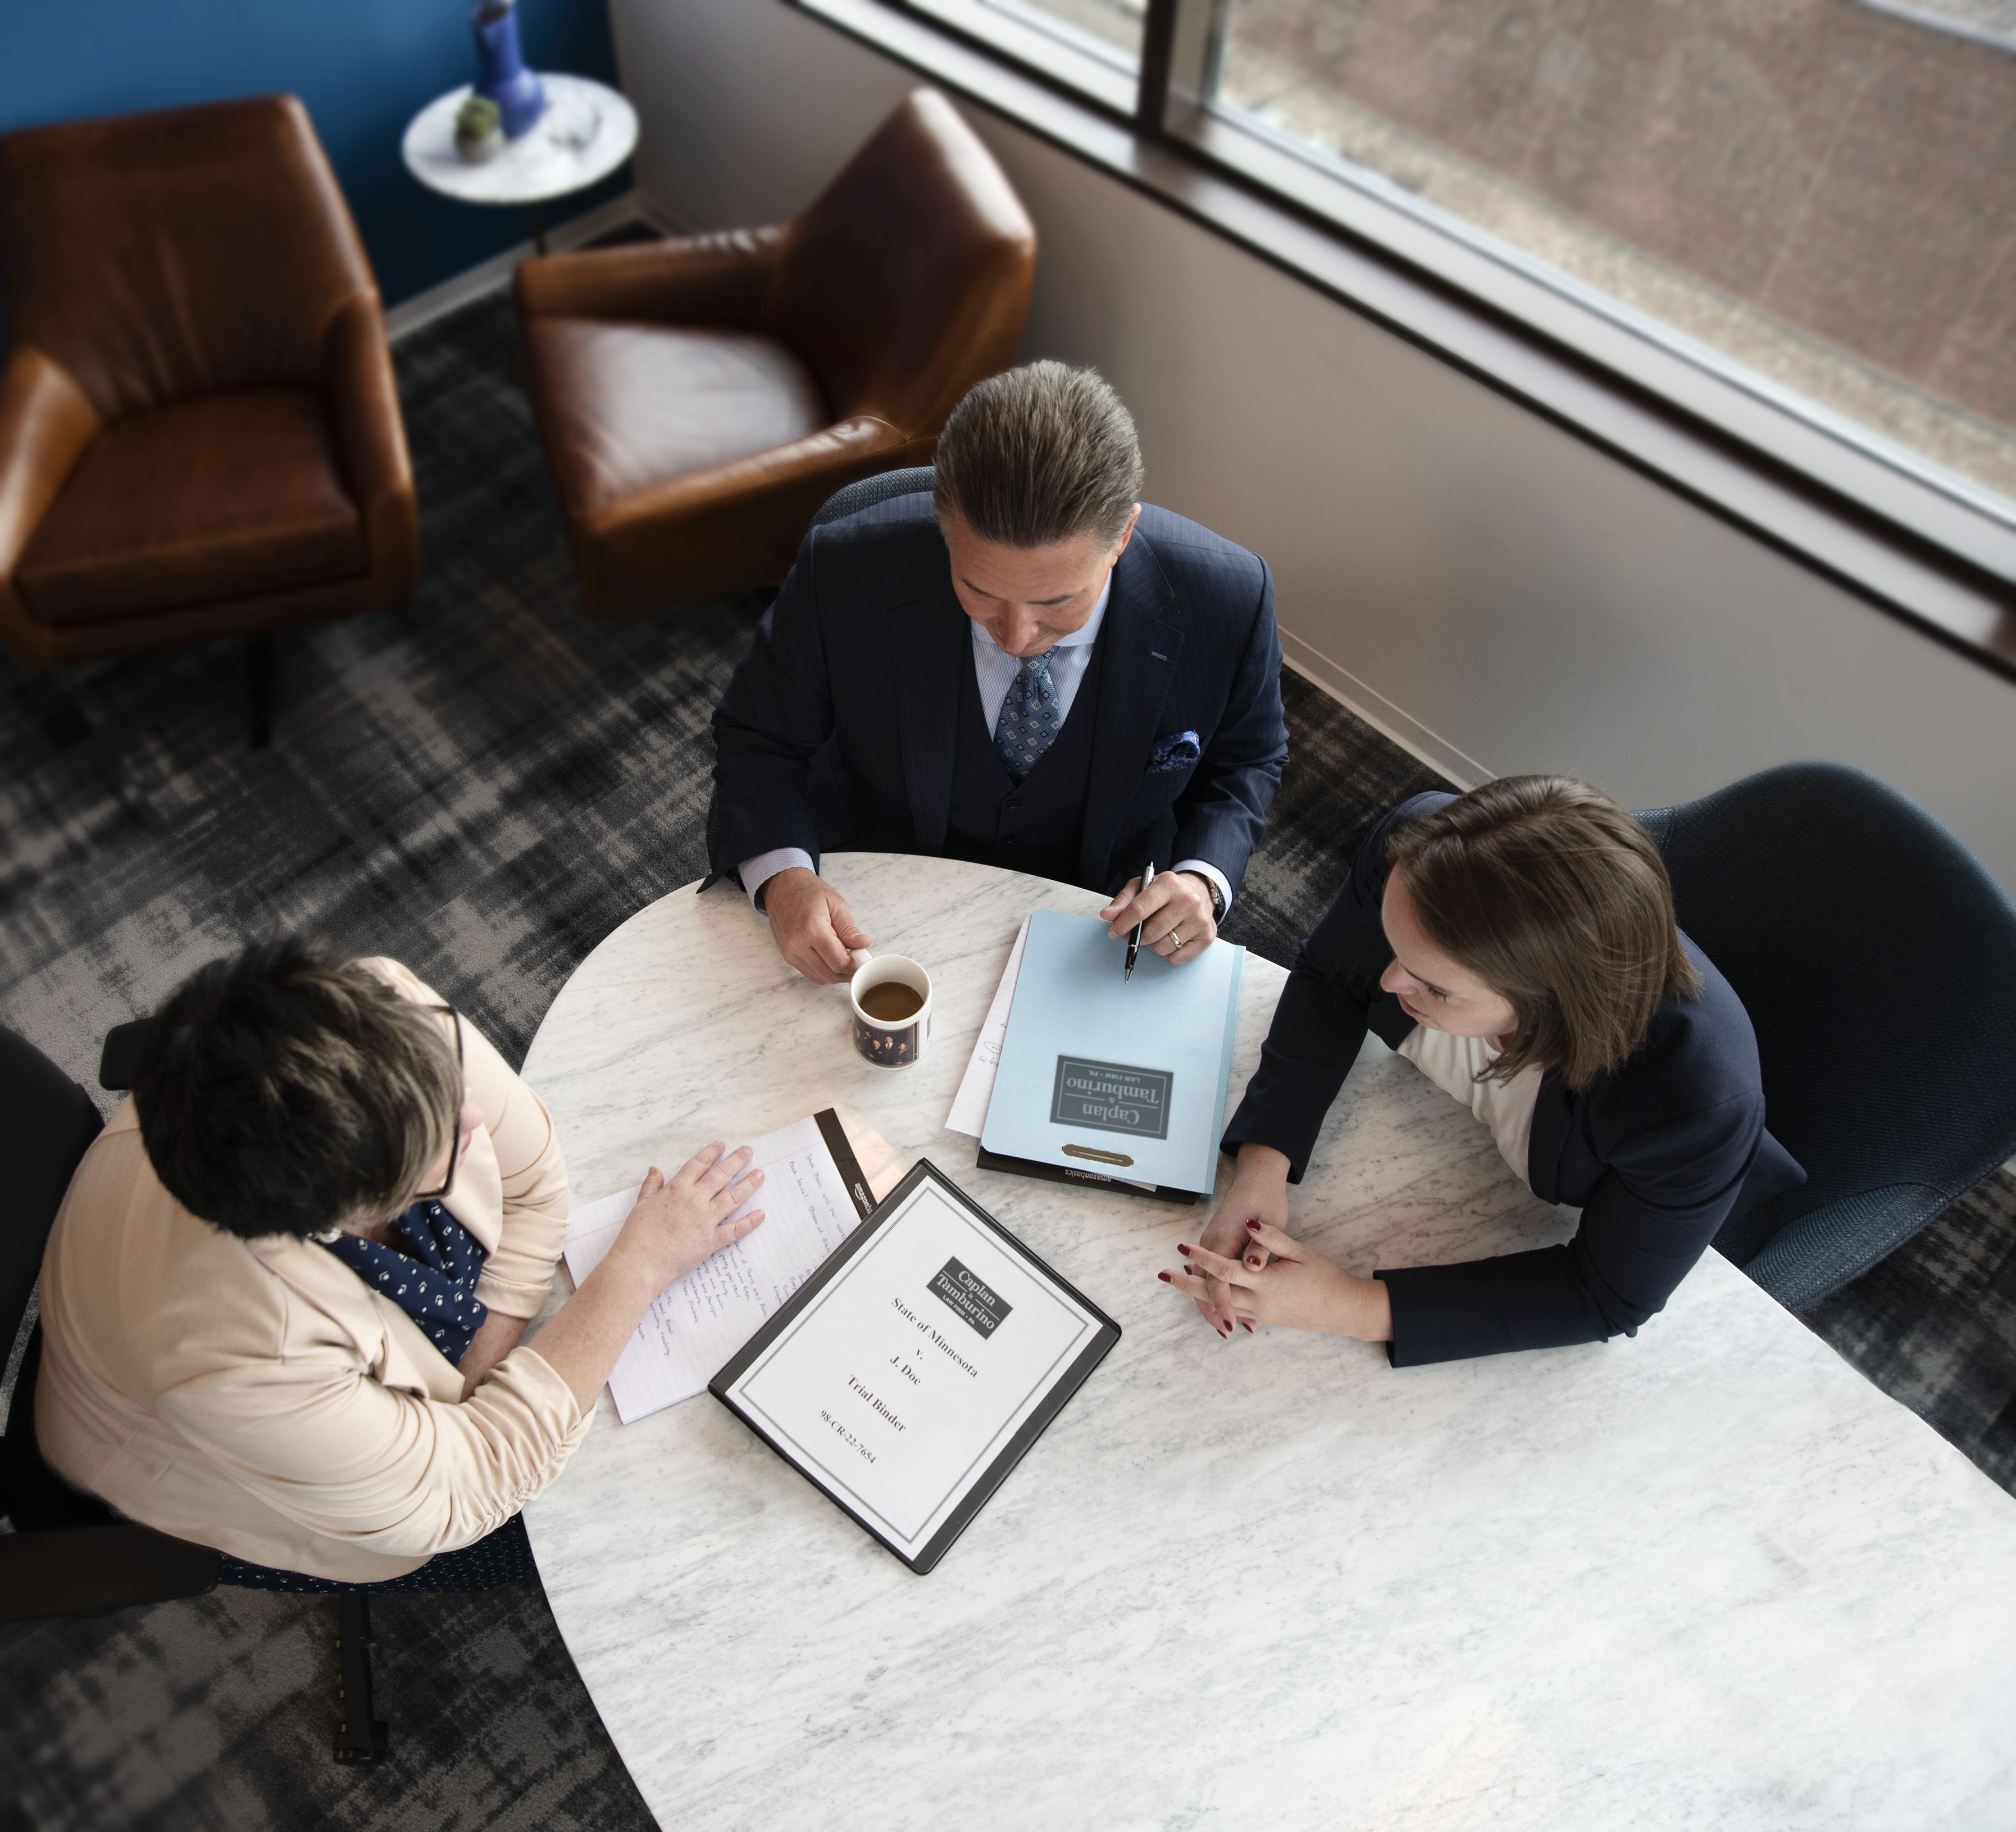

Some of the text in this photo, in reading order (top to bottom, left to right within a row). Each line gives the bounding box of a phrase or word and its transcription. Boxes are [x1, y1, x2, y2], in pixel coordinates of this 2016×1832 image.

[1067, 1078, 1159, 1104] Tamburino
[1082, 1103, 1140, 1125] Caplan
[1065, 1169, 1112, 1182] amazonbasics
[854, 1183, 872, 1215] amazonba
[936, 1274, 995, 1330] Tamburino
[958, 1270, 996, 1307] Caplan
[943, 1294, 975, 1325] LAW FIRM PA
[891, 1298, 978, 1378] State of Minnesota
[916, 1349, 922, 1360] v.
[890, 1356, 921, 1385] J. Doe
[848, 1375, 906, 1431] Trial Binder
[820, 1410, 876, 1463] 98-CR-22-7654
